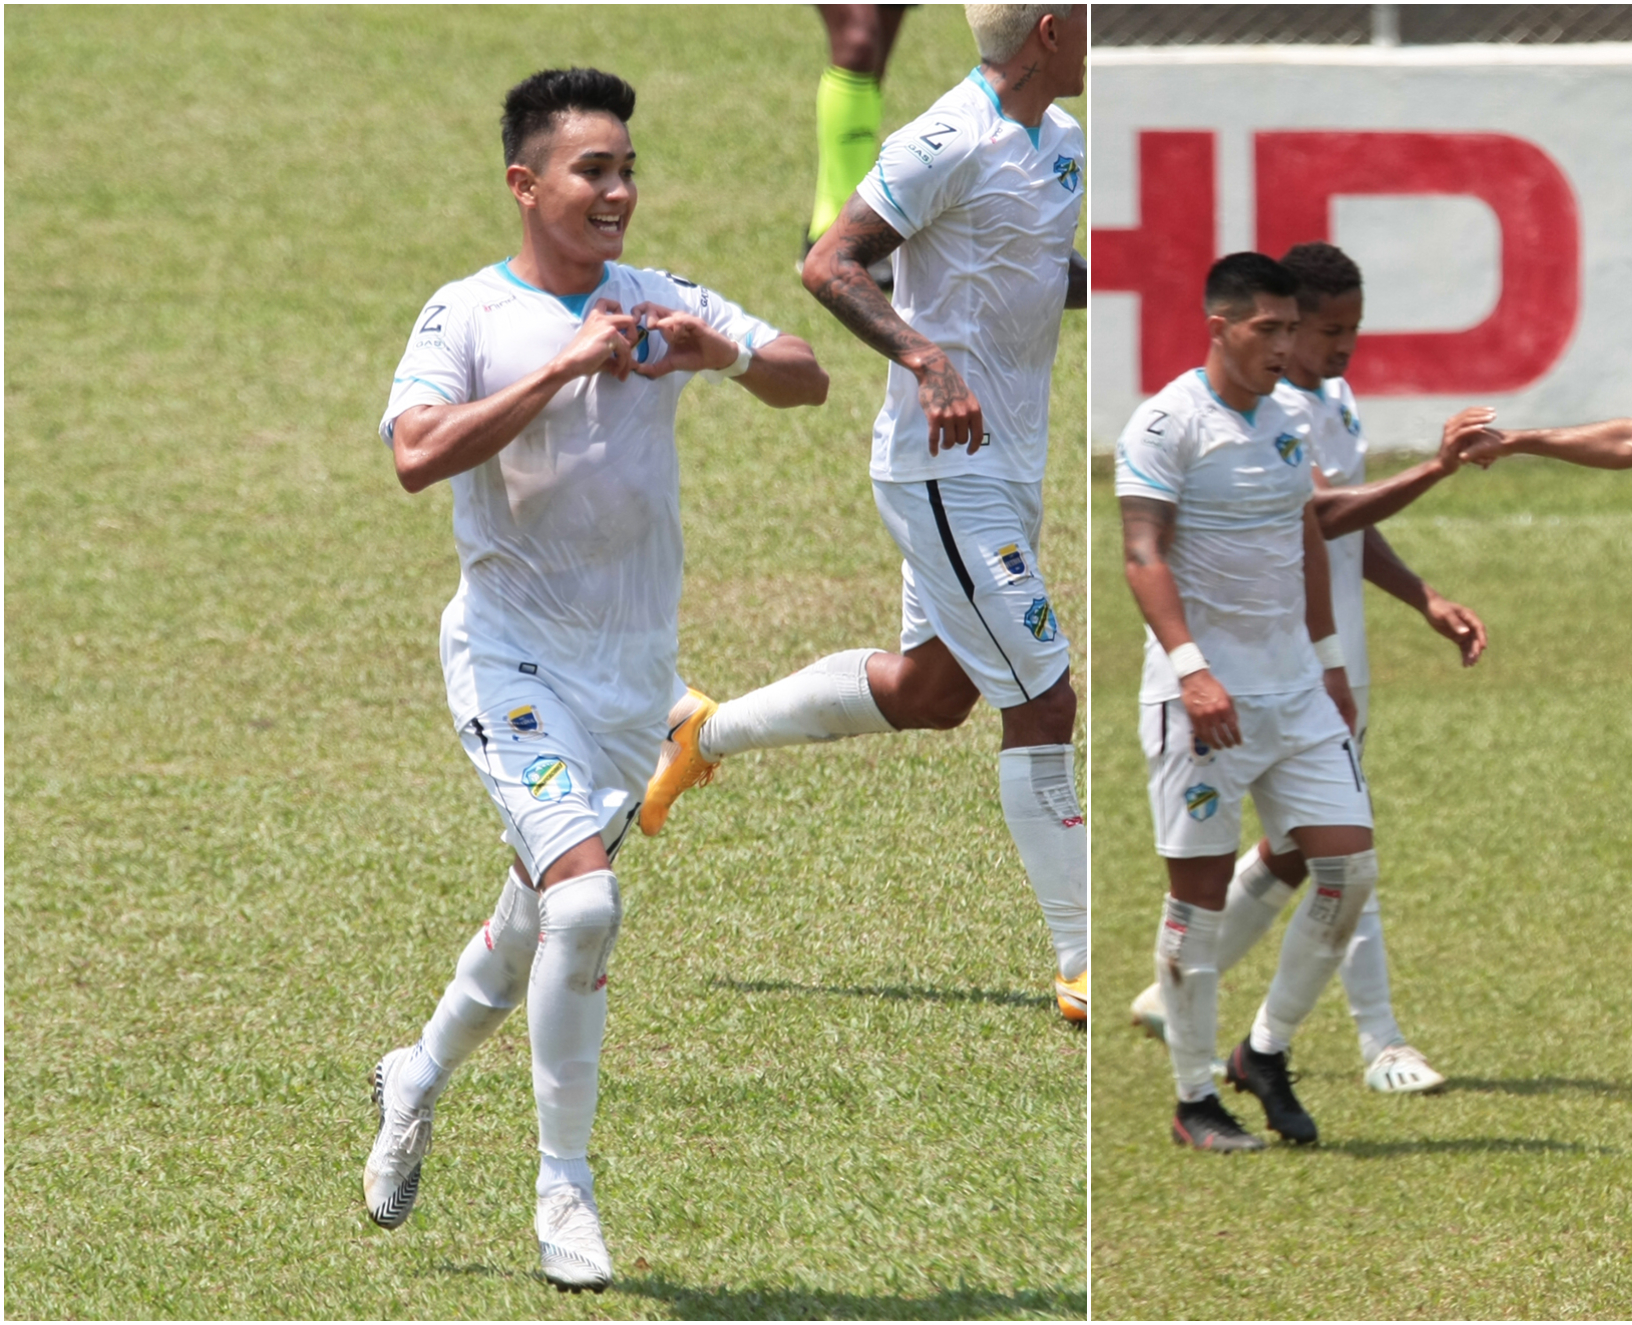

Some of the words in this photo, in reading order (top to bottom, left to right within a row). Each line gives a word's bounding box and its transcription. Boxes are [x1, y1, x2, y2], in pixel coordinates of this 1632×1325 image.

[919, 122, 957, 150] Z
[907, 143, 930, 162] GAS
[419, 304, 447, 334] Z
[1146, 409, 1169, 436] Z
